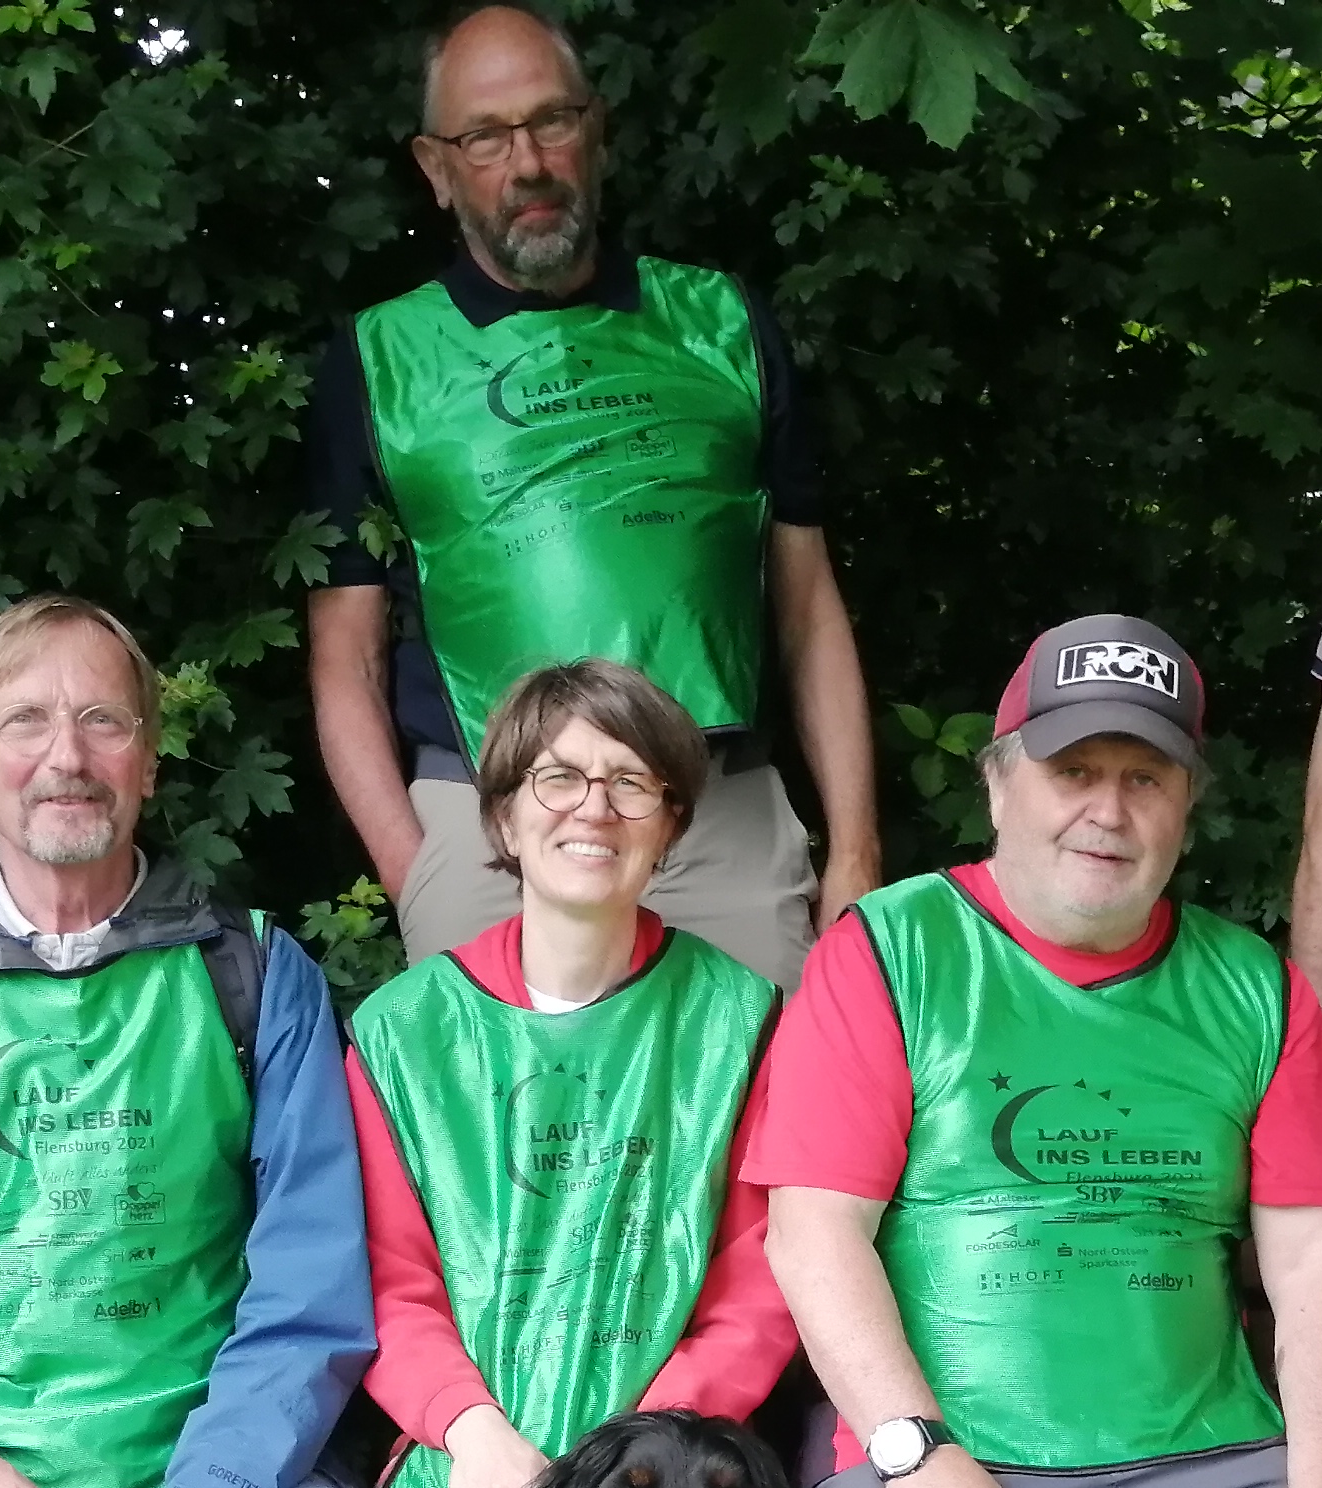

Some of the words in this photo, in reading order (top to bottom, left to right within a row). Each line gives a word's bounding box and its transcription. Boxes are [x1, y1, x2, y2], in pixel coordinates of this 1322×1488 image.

[522, 378, 585, 398] LAUF
[525, 398, 567, 415] INS
[577, 392, 654, 412] LEBEN
[623, 511, 675, 528] Adelby
[1063, 646, 1175, 694] IRON
[13, 1086, 80, 1107] LAUF
[66, 1109, 153, 1131] LEBEN
[530, 1120, 594, 1143] LAUF
[1038, 1128, 1118, 1142] LAUF
[35, 1138, 111, 1155] Flensburg
[116, 1136, 156, 1151] 2021
[533, 1151, 574, 1172] INS
[583, 1136, 653, 1169] LEBEN
[1037, 1149, 1090, 1165] INS
[1103, 1149, 1202, 1166] LEBEN
[48, 1188, 93, 1211] SBV
[1076, 1185, 1125, 1204] SBV
[119, 1199, 162, 1212] Doppel
[1127, 1272, 1184, 1290] Adelby
[1187, 1274, 1194, 1288] 1
[94, 1303, 150, 1322] Adelby
